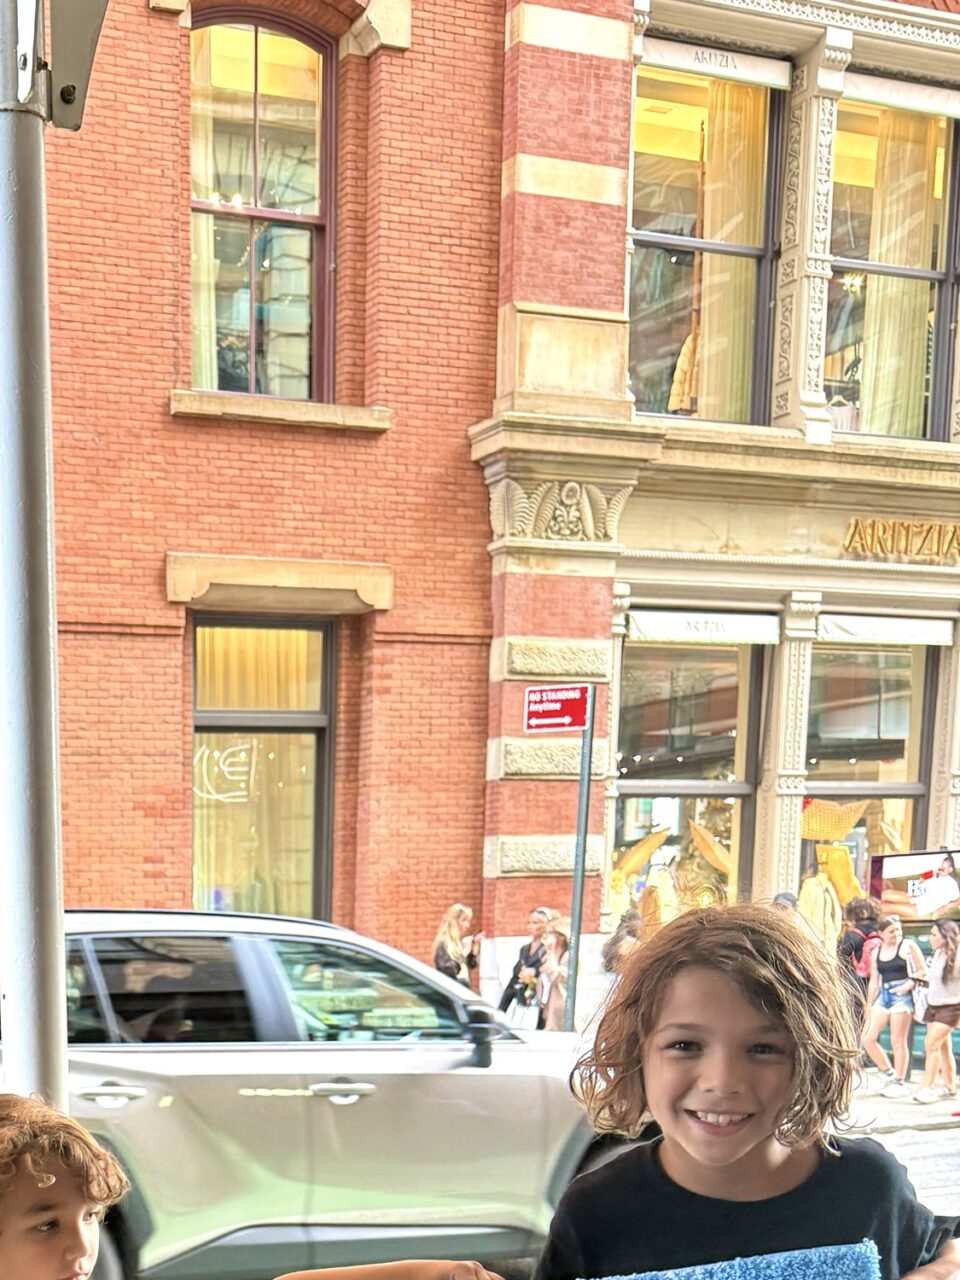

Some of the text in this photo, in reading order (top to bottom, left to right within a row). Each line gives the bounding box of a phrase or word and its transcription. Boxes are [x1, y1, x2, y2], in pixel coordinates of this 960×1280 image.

[843, 517, 960, 557] ARITZIA
[529, 689, 581, 701] NO STANDING
[529, 701, 561, 713] Anytime
